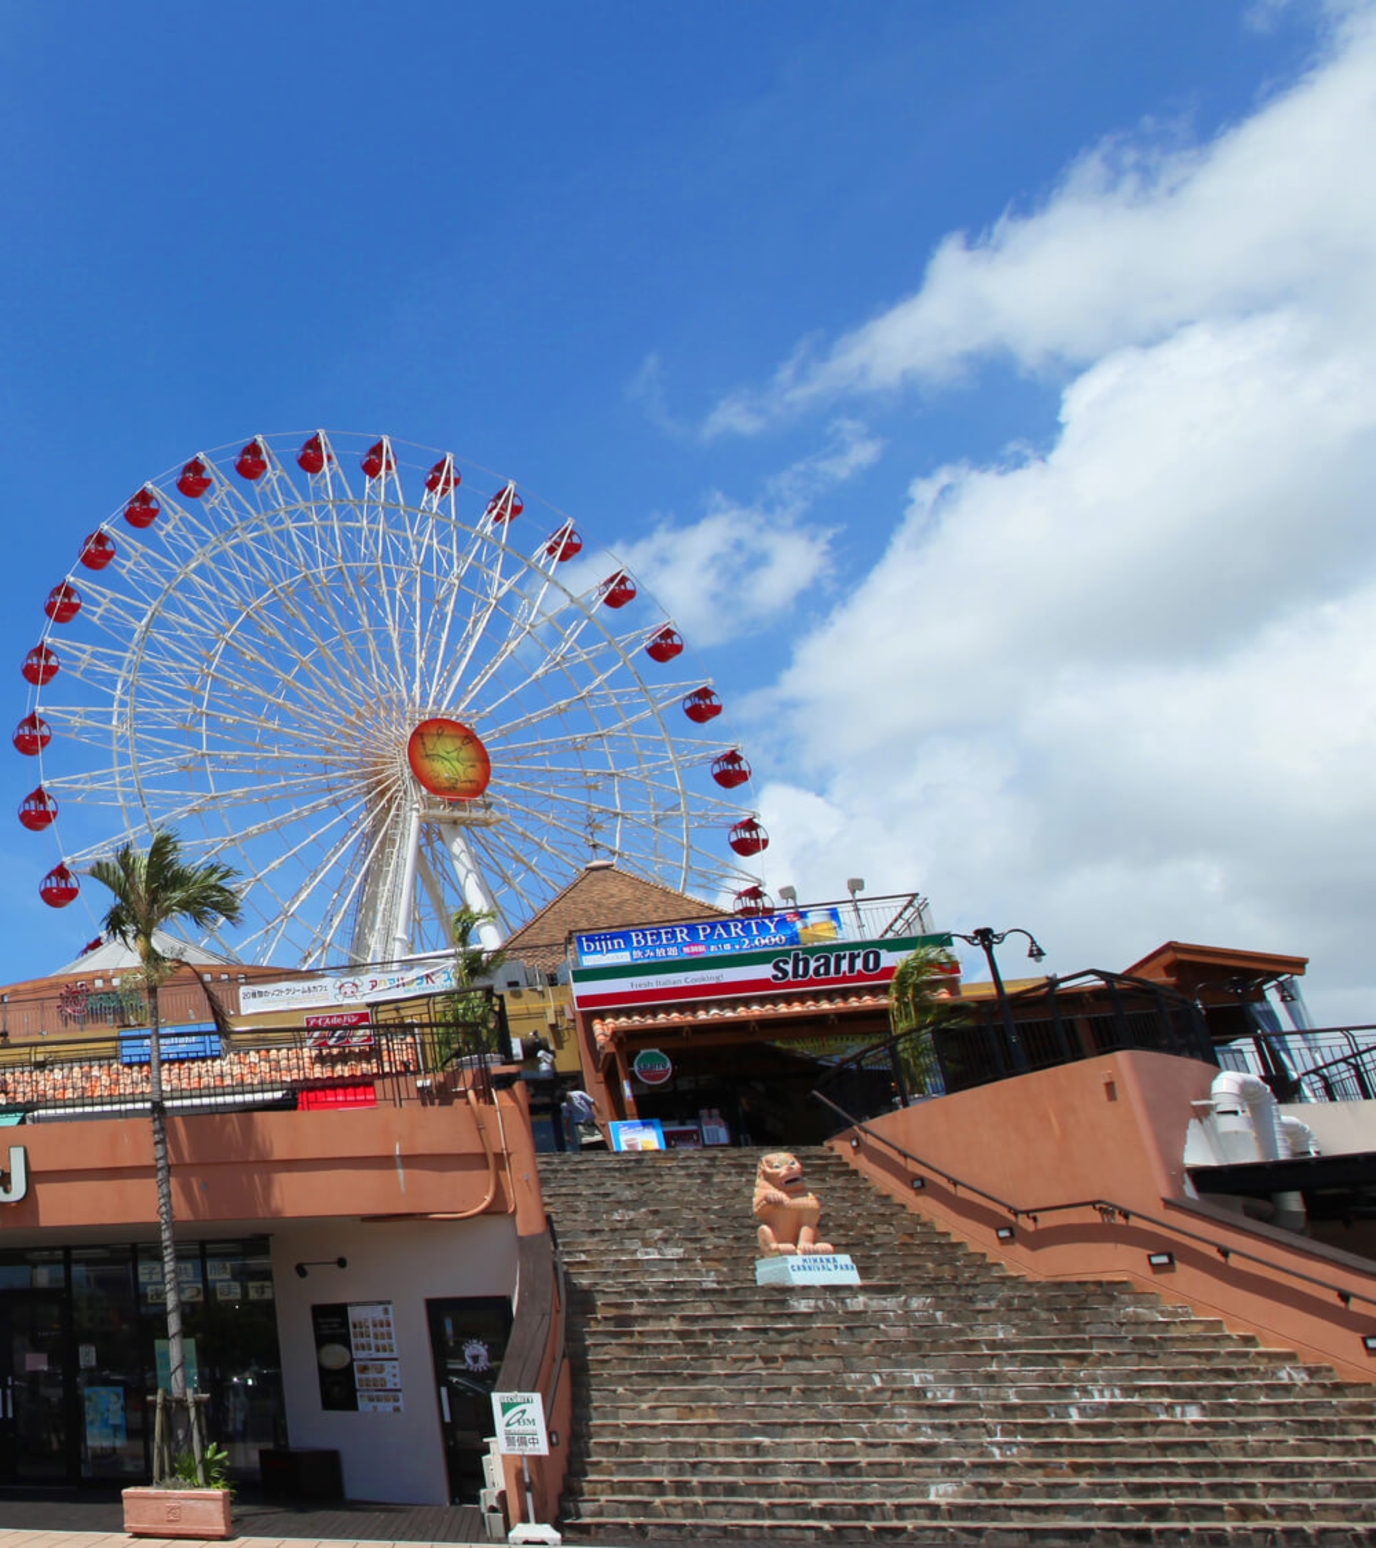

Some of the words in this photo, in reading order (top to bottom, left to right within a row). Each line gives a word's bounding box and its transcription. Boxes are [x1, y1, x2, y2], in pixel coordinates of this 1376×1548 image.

[581, 935, 626, 957] bijin
[630, 925, 691, 948] BEER
[696, 917, 780, 942] PARTY
[771, 949, 882, 982] sbarro
[630, 979, 654, 990] Fresh
[655, 976, 682, 988] Italian
[684, 974, 724, 986] Cooking!
[790, 1264, 832, 1272] CARNIVAL
